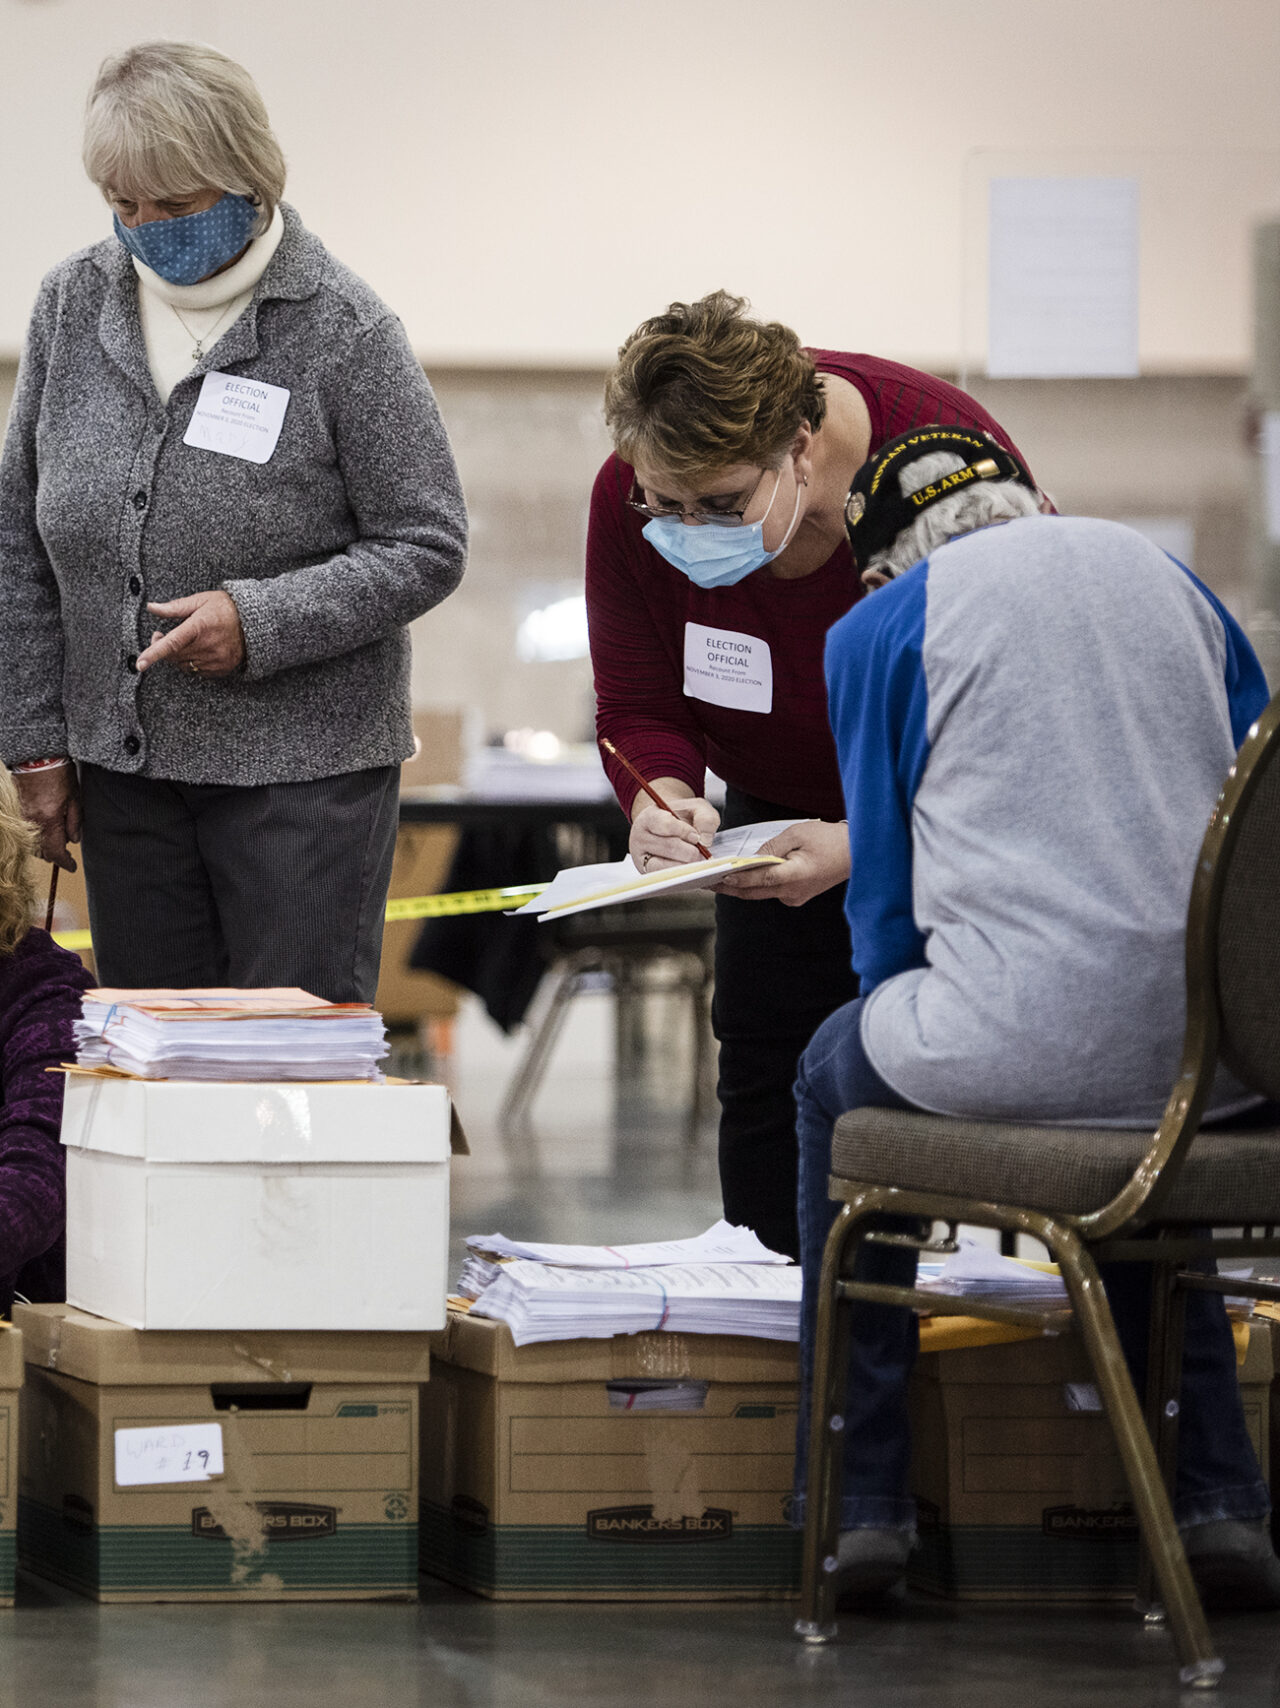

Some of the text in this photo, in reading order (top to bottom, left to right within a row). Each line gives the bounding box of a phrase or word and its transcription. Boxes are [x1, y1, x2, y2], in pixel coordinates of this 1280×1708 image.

[225, 382, 269, 400] ELECTION
[222, 396, 261, 413] OFFICIAL
[871, 432, 984, 495] WOMAN VETERAN
[912, 485, 941, 505] U.S.
[706, 638, 752, 654] ELECTION
[707, 652, 749, 667] OFFICIAL
[736, 677, 762, 687] ELECTION
[182, 1449, 210, 1471] 19
[290, 1515, 328, 1527] BOX
[596, 1518, 725, 1531] BANKERS BOX
[1051, 1516, 1138, 1528] BANKERS
